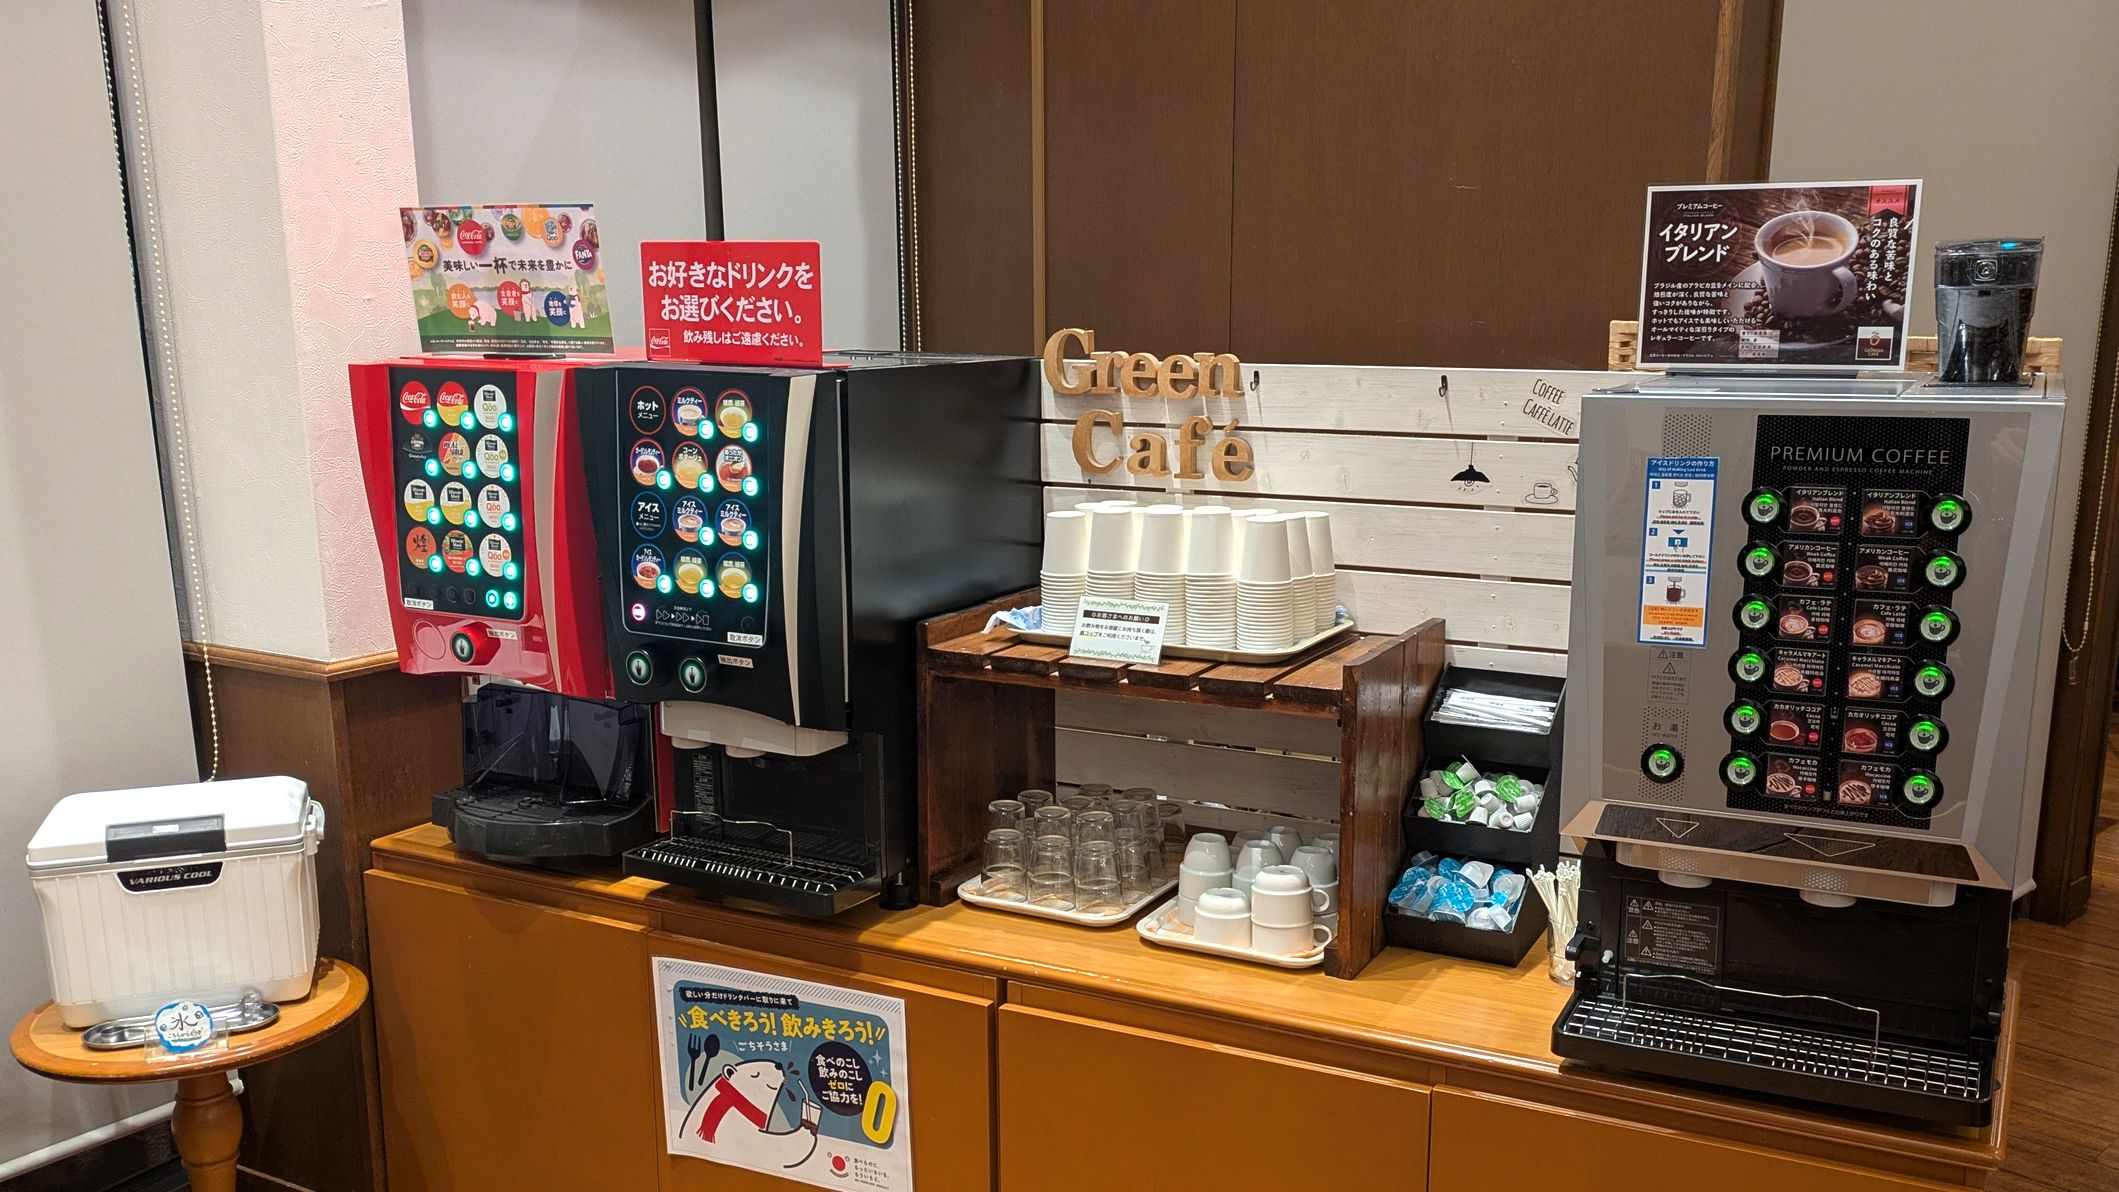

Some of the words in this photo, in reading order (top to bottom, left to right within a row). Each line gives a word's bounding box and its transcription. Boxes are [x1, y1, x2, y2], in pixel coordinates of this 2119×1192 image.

[1677, 202, 1723, 210] プレミアムコーヒー
[1659, 222, 1738, 242] イタリアン
[1665, 243, 1730, 262] ブレンド
[1884, 216, 1899, 282] 良質な苦味と
[443, 256, 572, 274] 美味しい一杯で未来を豊かに
[1865, 218, 1882, 301] コクのある味わい
[648, 260, 814, 290] お好きなドリンクを
[661, 294, 802, 325] お選びください。
[683, 330, 804, 348] 飲み残しはご遠慮ください。
[1044, 328, 1246, 400] Green
[1532, 378, 1565, 405] COFFEE
[637, 400, 659, 411] ホット
[677, 396, 702, 405] ミルクティー
[637, 412, 659, 420] メニュー
[1072, 408, 1254, 482] Café
[678, 453, 702, 462] ポタージュ
[1770, 446, 1863, 462] PREMIUM
[1871, 448, 1950, 465] COFFEE
[638, 502, 660, 513] アイス
[682, 500, 696, 508] アイス
[638, 513, 660, 521] メニュー
[677, 507, 703, 515] ミルクティー
[720, 510, 747, 518] ミルクティー
[730, 634, 760, 644] 取消ボタン
[1778, 650, 1826, 658] キャラメルマキアート
[1852, 656, 1901, 664] キャラメルマキアート
[1774, 704, 1822, 712] カカオリッチココア
[1848, 712, 1897, 720] カカオリッチココア
[1788, 758, 1818, 766] カフェモカ
[1861, 765, 1891, 773] カフェモカ
[129, 872, 180, 886] VARIOUS
[184, 870, 213, 880] COOL
[685, 990, 792, 1006] 欲しい分だけドリンクバーに取りに来て
[170, 1012, 198, 1031] 氷
[738, 1040, 788, 1052] ごちそうさま
[815, 1054, 860, 1070] 食べのこし
[818, 1067, 863, 1082] 飲みのこし
[828, 1080, 854, 1092] ゼロに
[862, 1080, 897, 1144] 0
